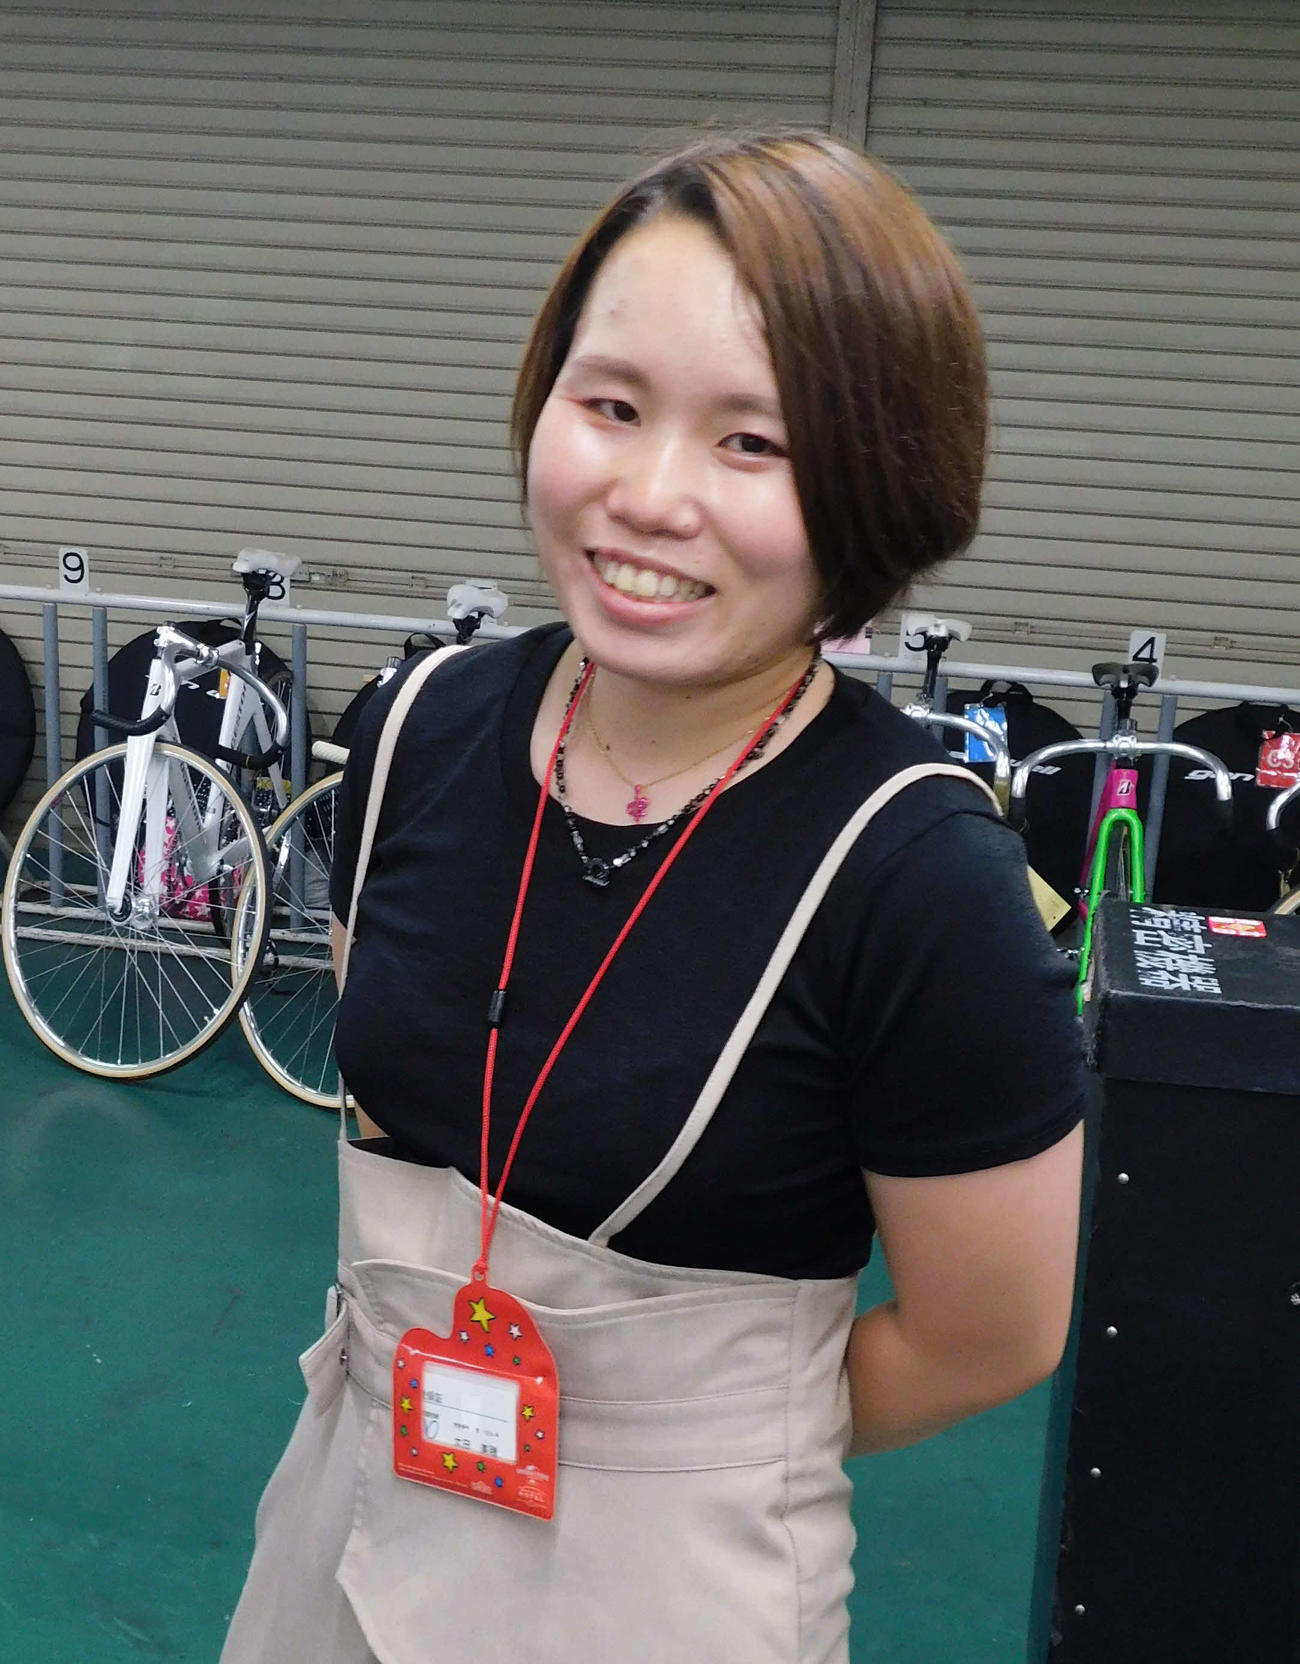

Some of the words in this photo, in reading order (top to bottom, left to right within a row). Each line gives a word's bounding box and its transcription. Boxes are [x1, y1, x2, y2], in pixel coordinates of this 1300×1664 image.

[62, 551, 85, 584] 9
[1132, 636, 1159, 663] 4
[1130, 907, 1222, 993] 精密機器
